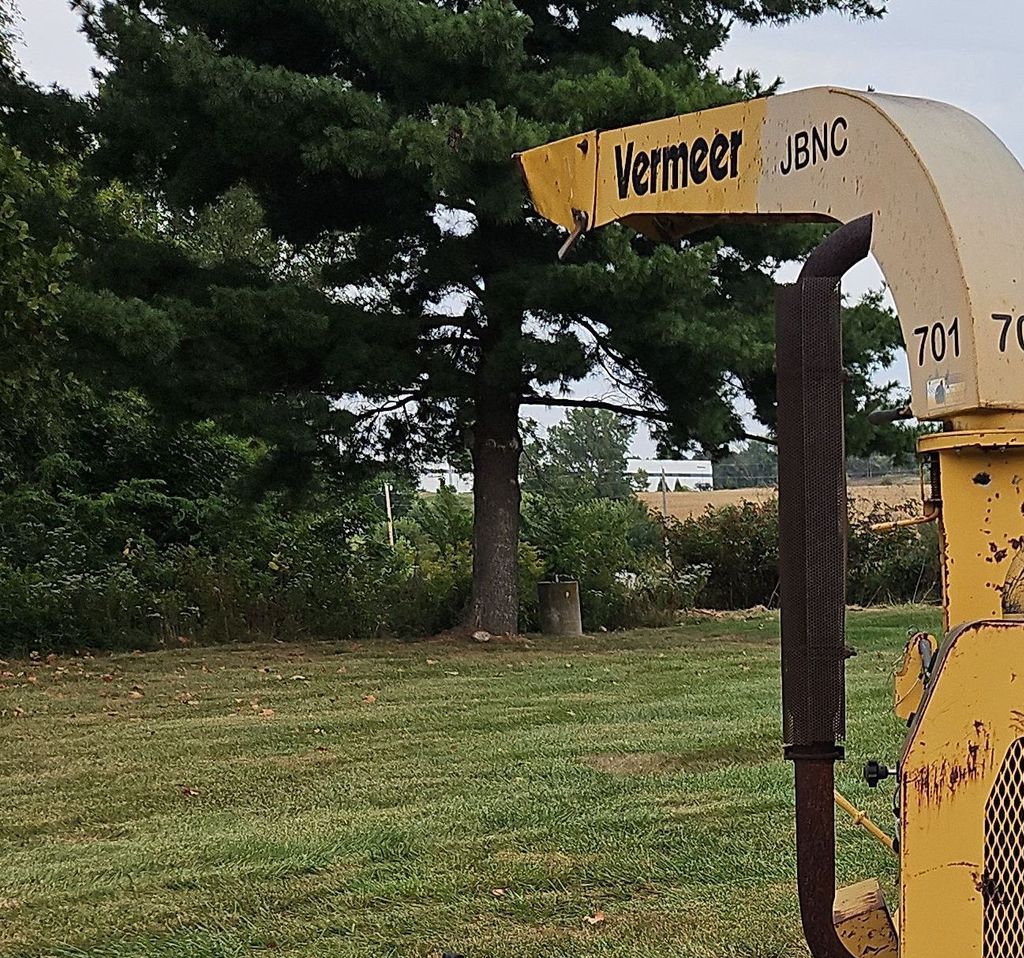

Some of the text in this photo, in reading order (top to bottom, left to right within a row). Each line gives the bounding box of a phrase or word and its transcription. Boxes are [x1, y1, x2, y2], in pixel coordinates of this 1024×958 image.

[615, 129, 743, 200] Vermeer
[780, 116, 848, 176] JBNC
[914, 316, 960, 367] 701
